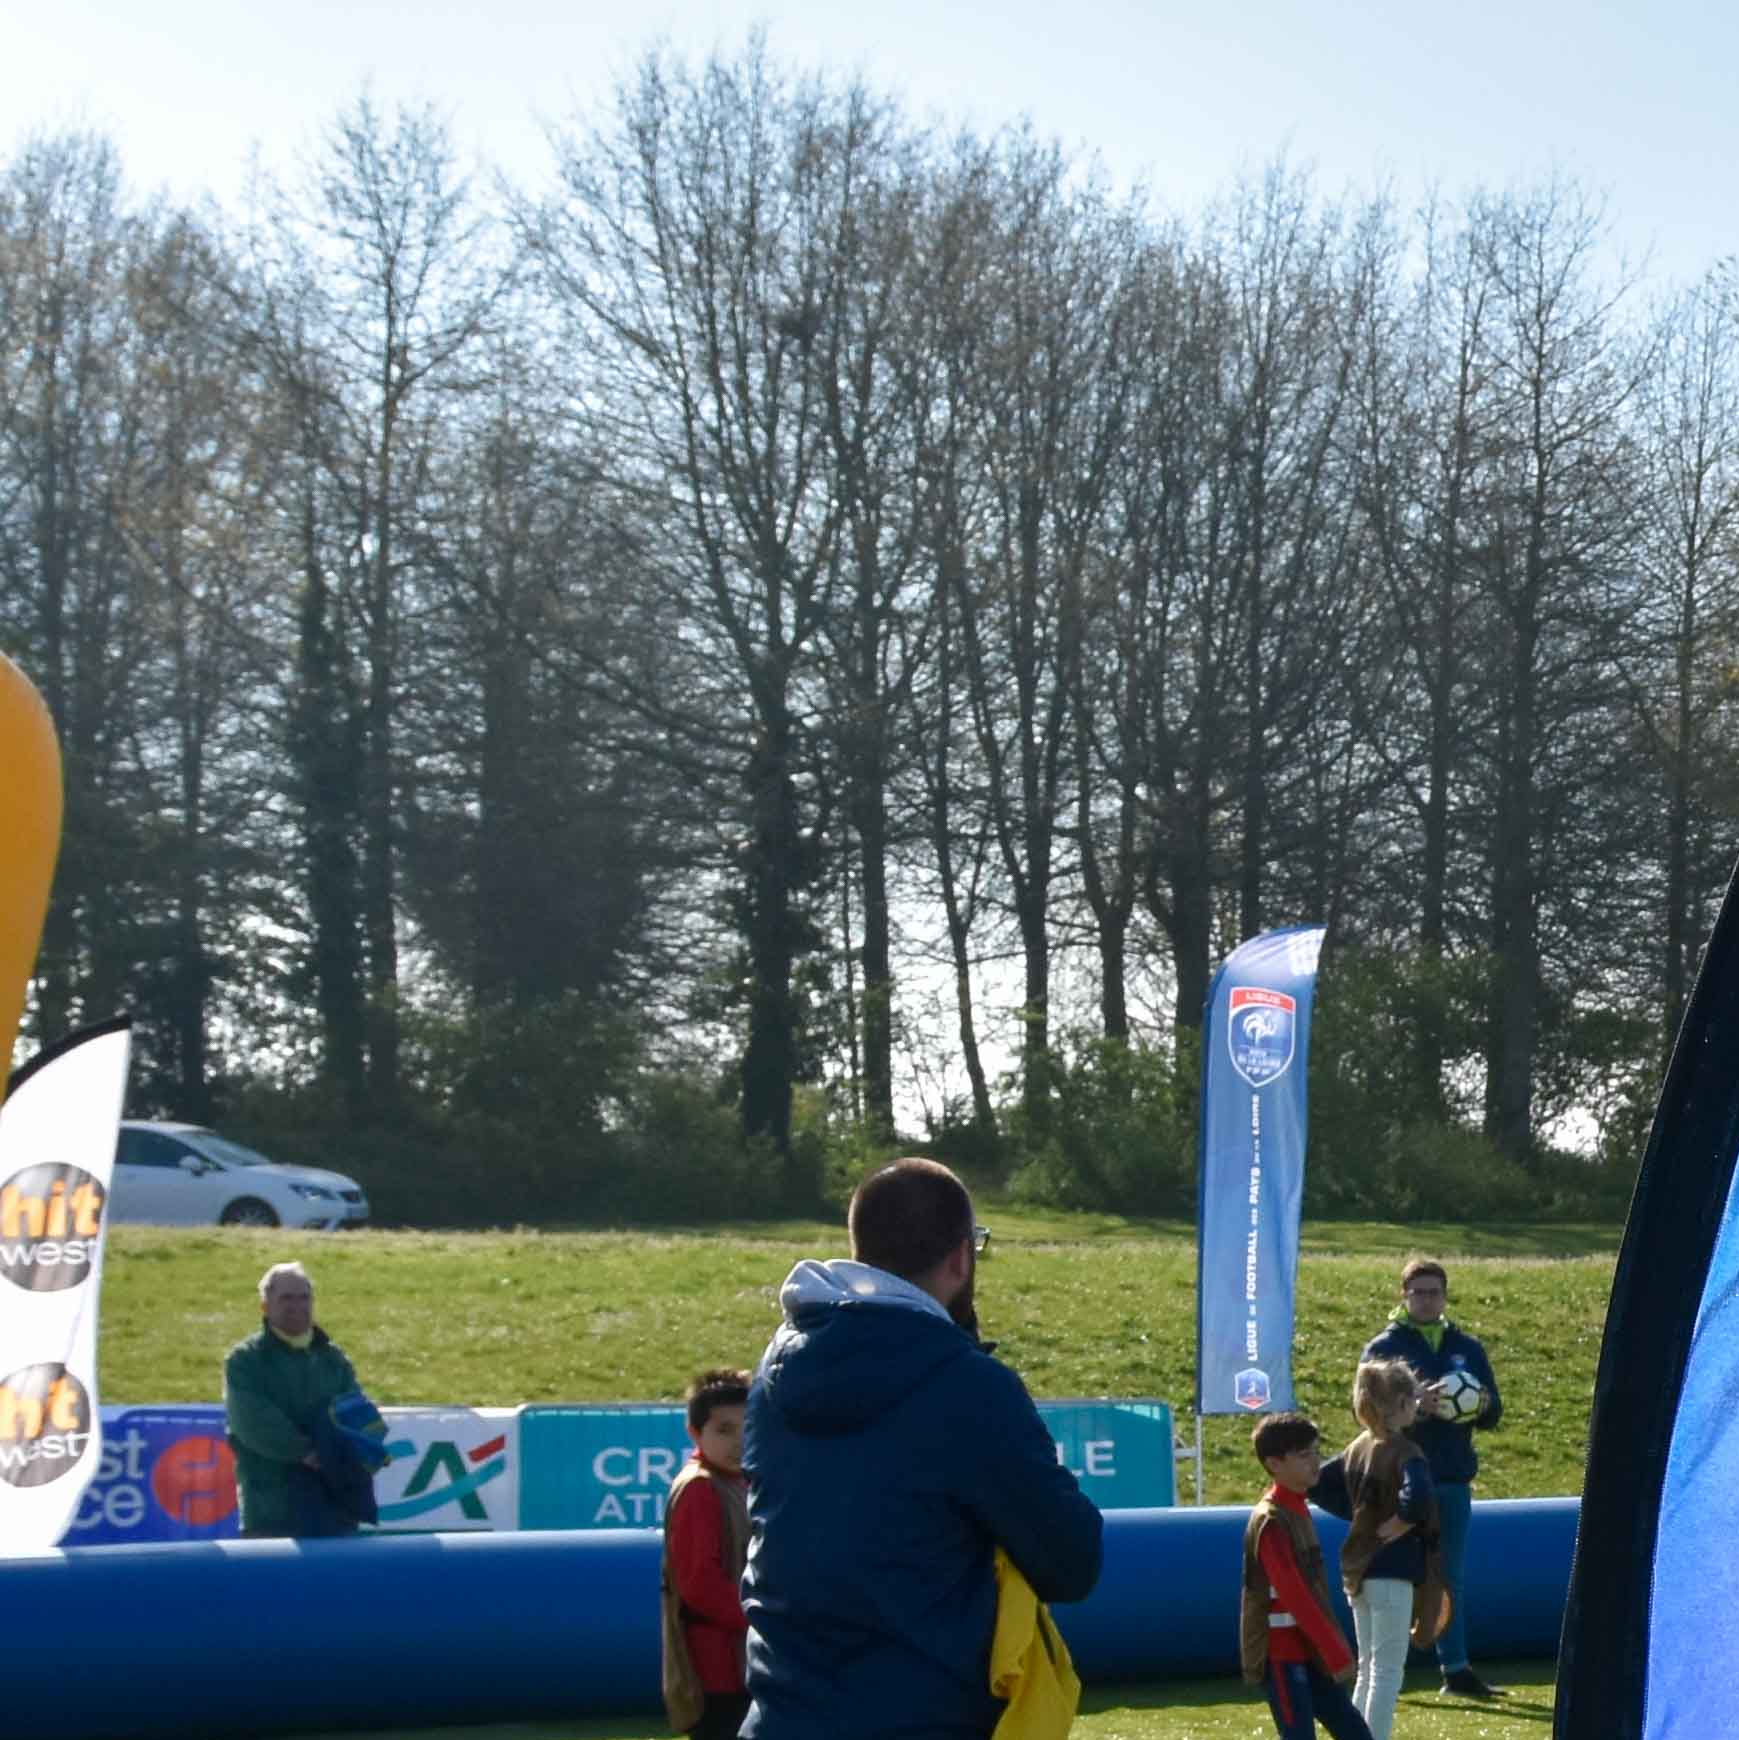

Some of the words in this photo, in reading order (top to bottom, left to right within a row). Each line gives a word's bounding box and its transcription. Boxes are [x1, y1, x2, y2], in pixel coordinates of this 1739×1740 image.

[0, 1177, 101, 1238] hit
[1249, 1167, 1260, 1204] PAYS
[1246, 1229, 1257, 1300] FOOTBALL
[1246, 1320, 1258, 1361] LIGUE
